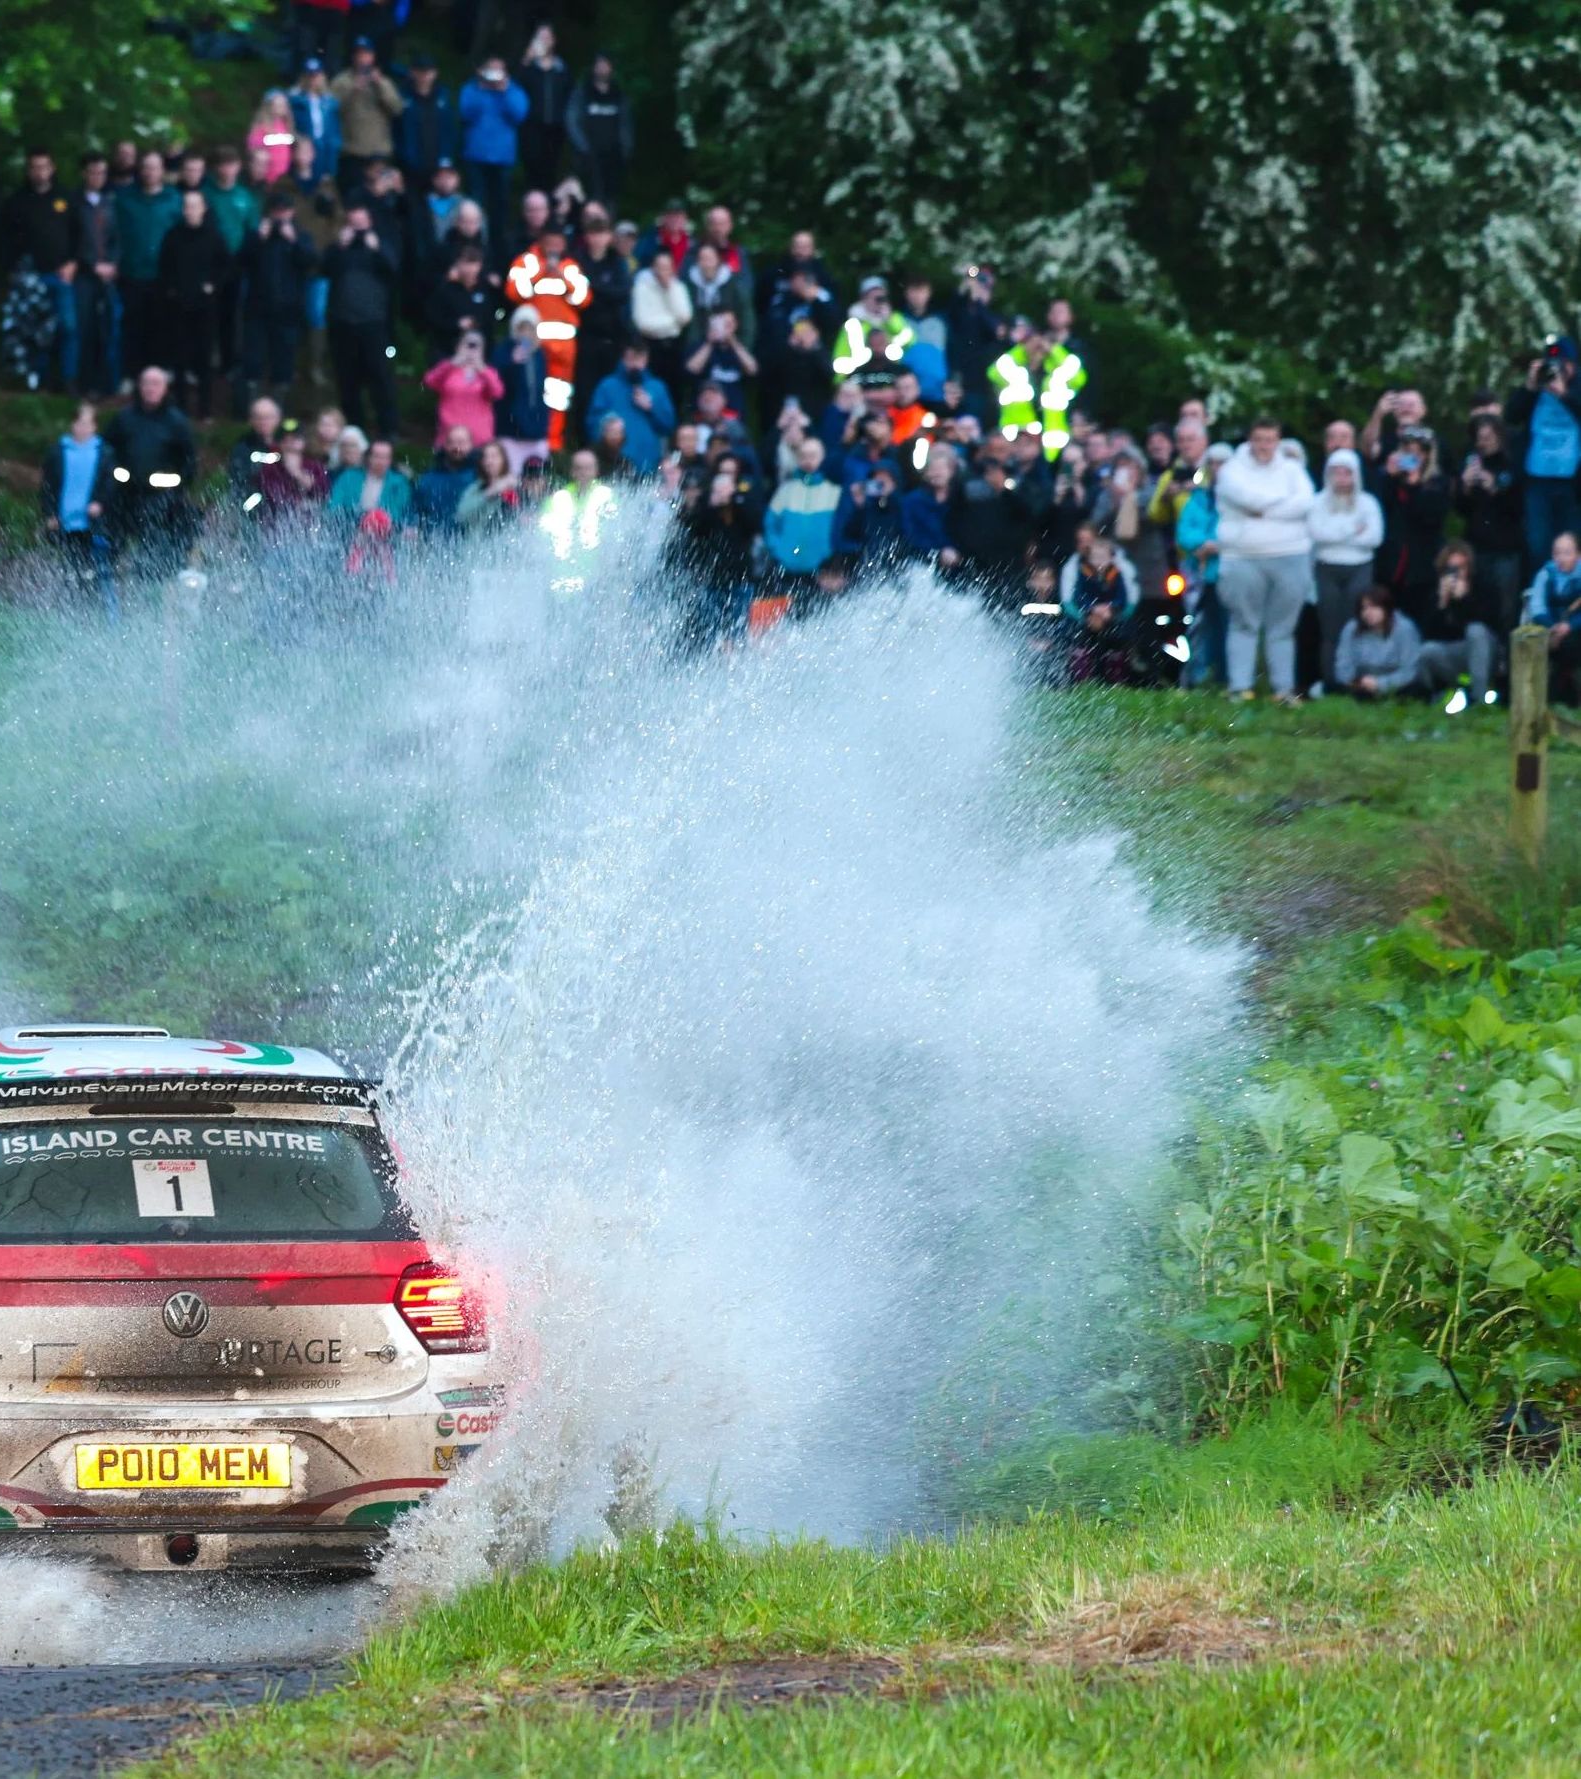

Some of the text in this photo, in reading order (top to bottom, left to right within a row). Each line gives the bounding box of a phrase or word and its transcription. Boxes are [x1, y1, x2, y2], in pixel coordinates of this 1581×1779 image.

[1, 1128, 325, 1154] ISLAND CAR CENTRE
[166, 1175, 184, 1212] 1
[302, 1379, 342, 1390] GROUP
[200, 1448, 269, 1481] MEM
